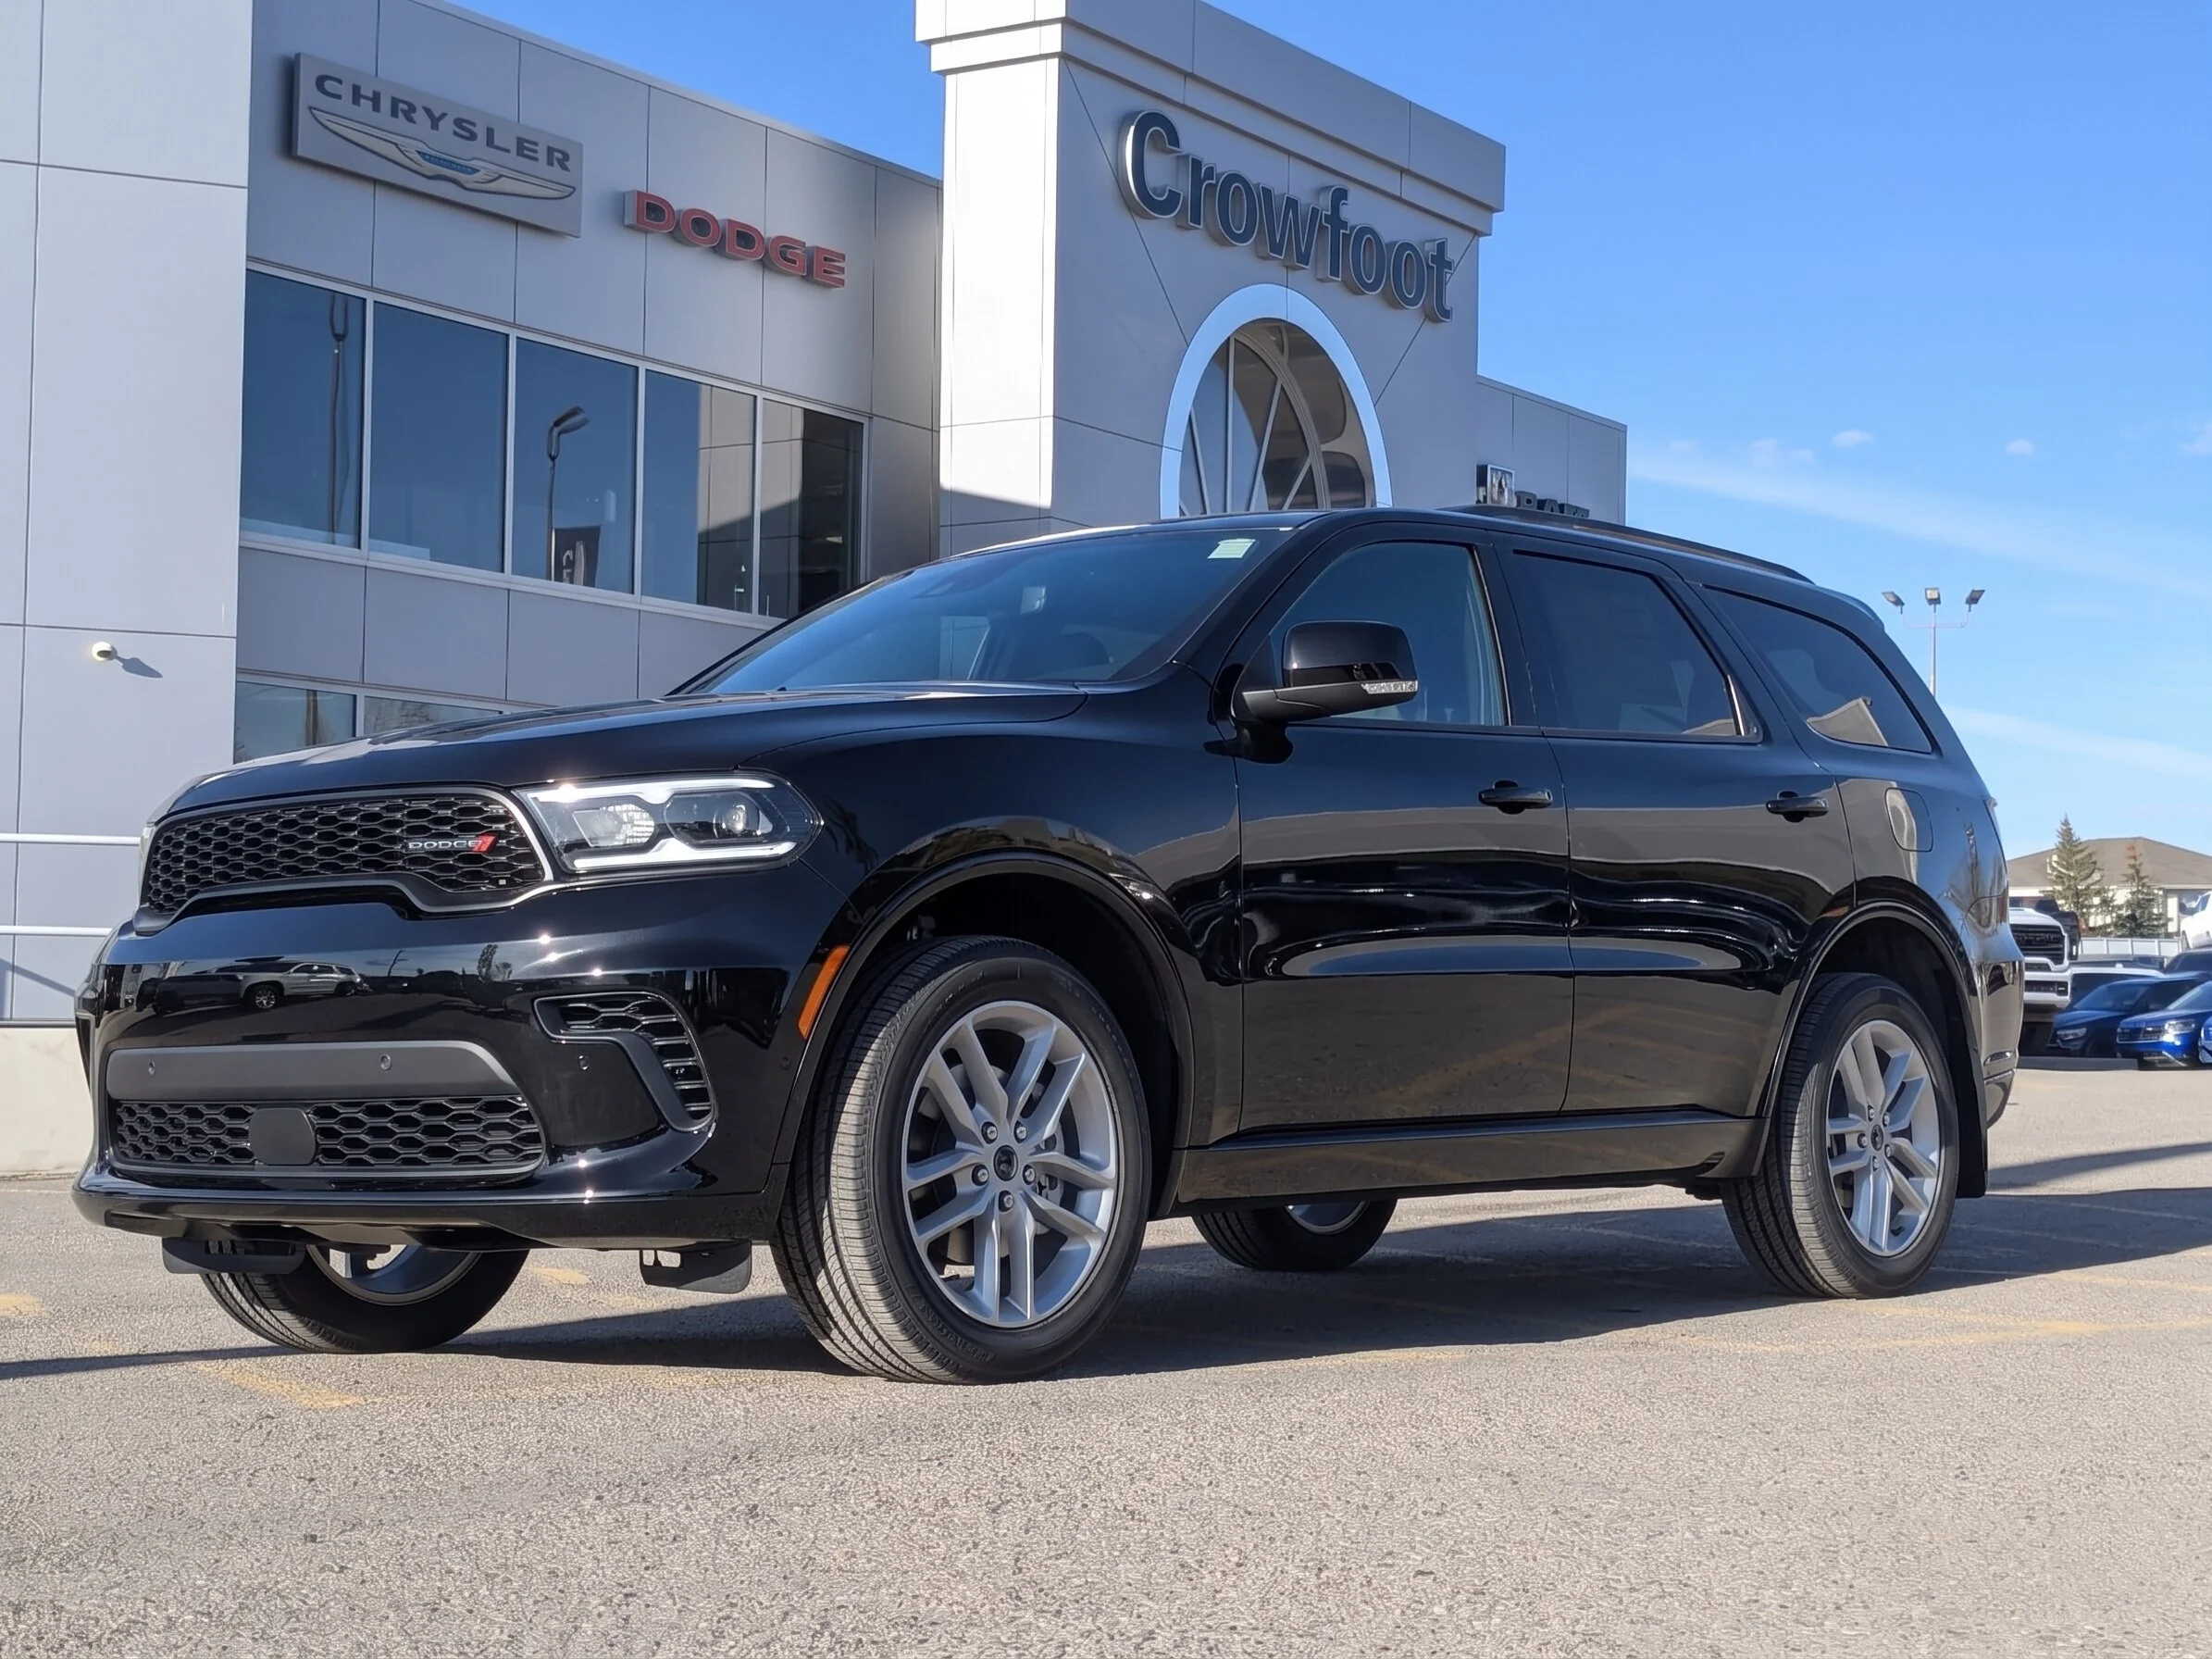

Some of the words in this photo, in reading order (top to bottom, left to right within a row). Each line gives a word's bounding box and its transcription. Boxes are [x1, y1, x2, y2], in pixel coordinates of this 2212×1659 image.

[315, 74, 571, 172] CHRYSLER
[631, 190, 846, 289] DODGE
[1123, 110, 1455, 322] Crowfoot
[408, 840, 482, 849] DODGE
